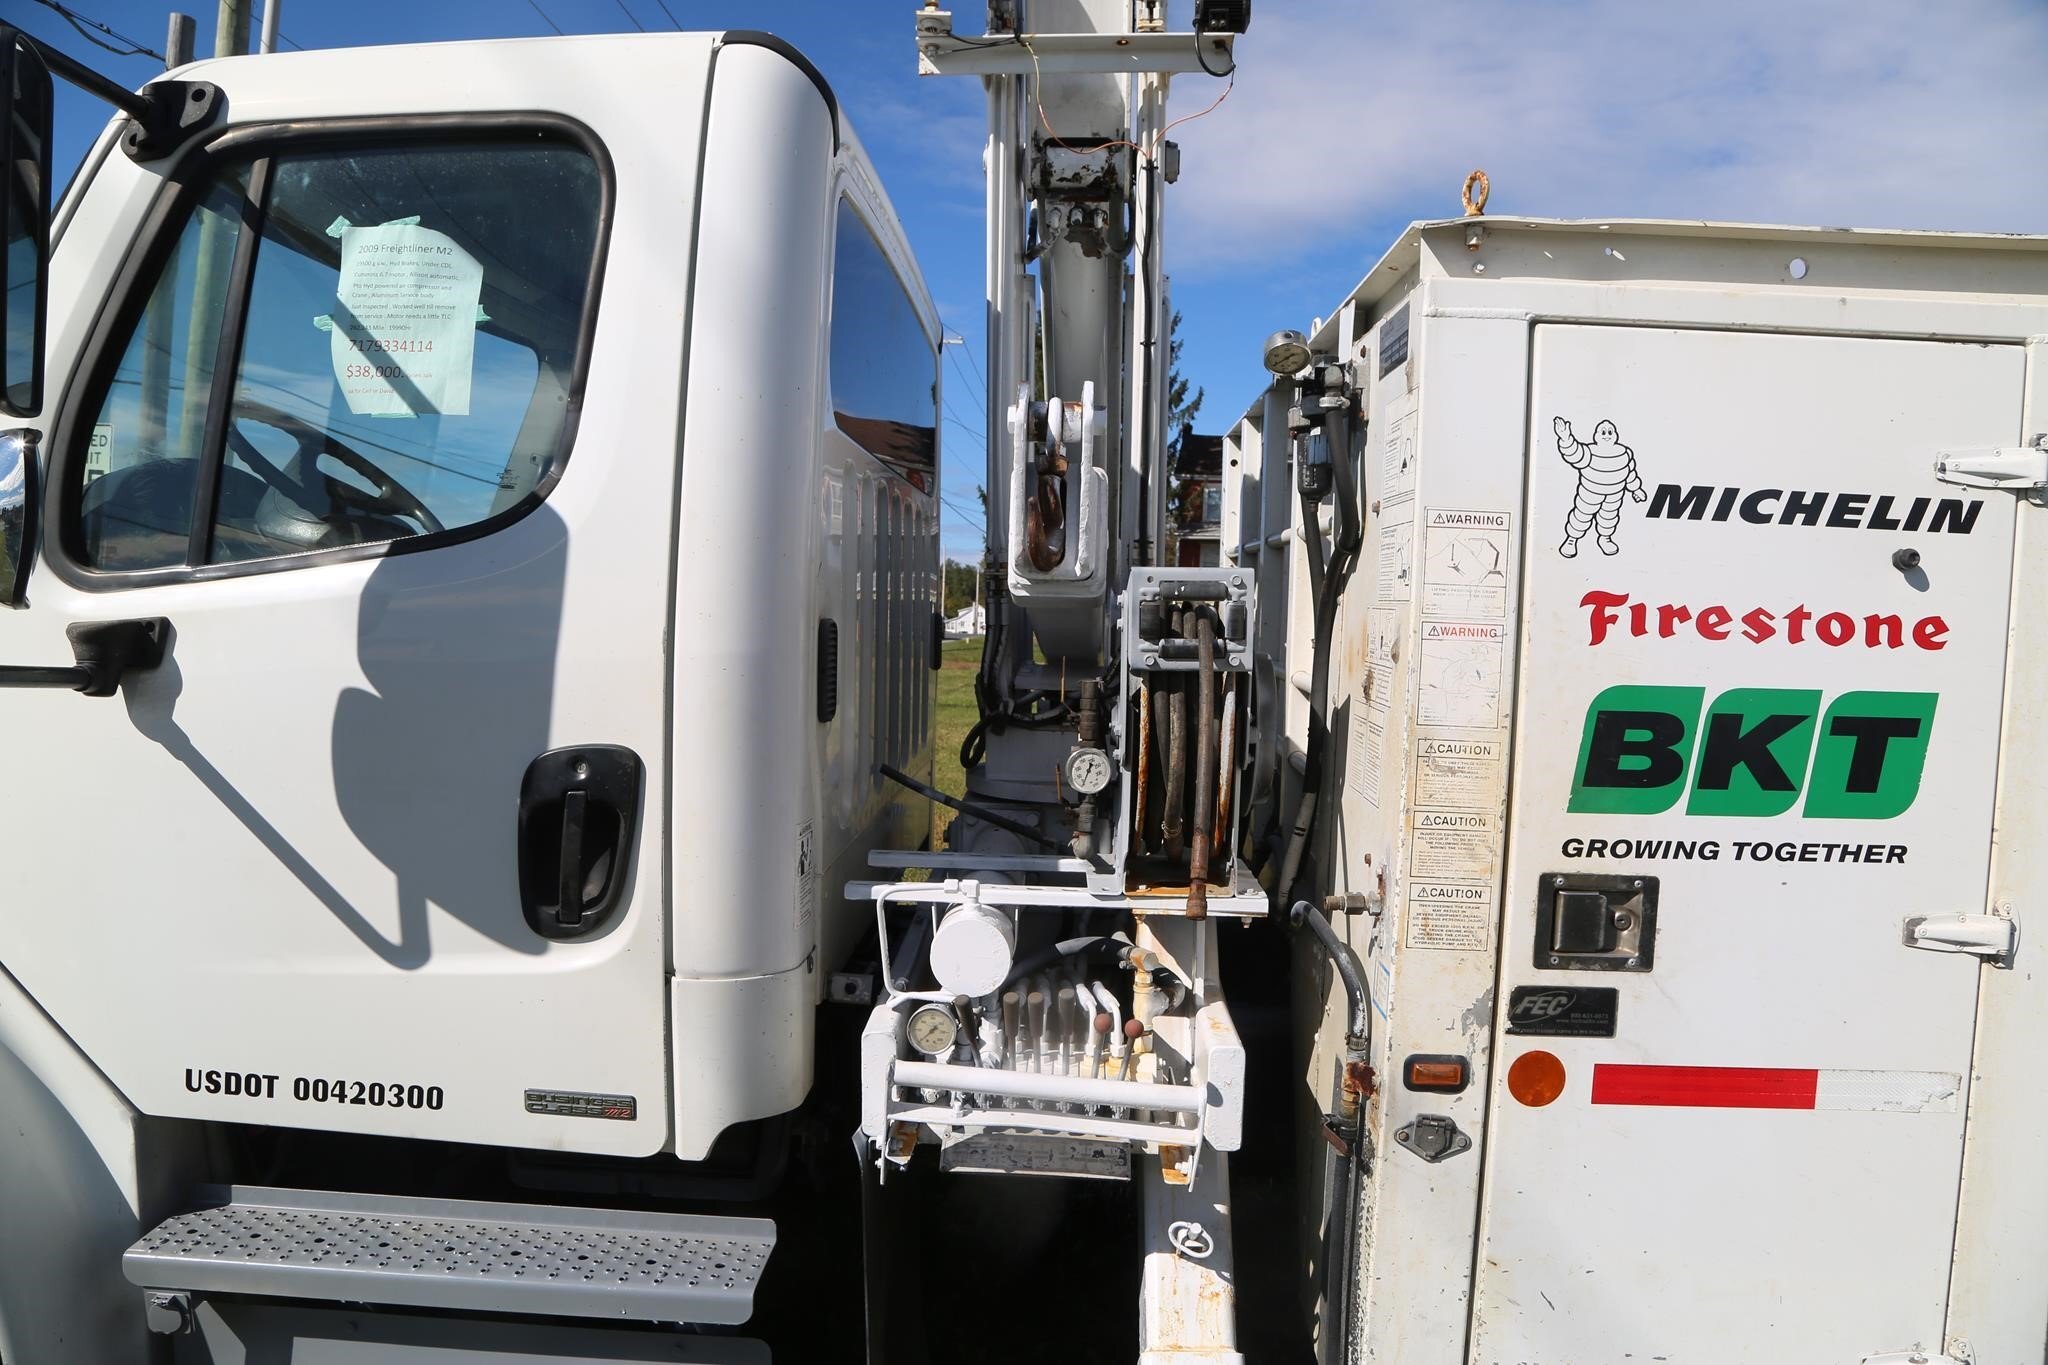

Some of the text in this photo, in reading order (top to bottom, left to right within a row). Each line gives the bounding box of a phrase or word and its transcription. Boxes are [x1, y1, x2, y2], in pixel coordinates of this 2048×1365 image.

[359, 244, 453, 255] 2009 Freightliner M2
[349, 340, 433, 352] 7179334114
[1645, 484, 1985, 535] MICHELIN
[1446, 514, 1503, 526] WARNING
[1579, 590, 1951, 651] Firestone
[1440, 626, 1497, 638] WARNING
[1438, 744, 1491, 755] CAUTION
[1582, 710, 1922, 793] BKT
[1434, 816, 1486, 827] CAUTION
[1562, 838, 1908, 864] GROWING TOGETHER
[1430, 888, 1482, 899] CAUTION
[1516, 996, 1568, 1016] FEC
[185, 1068, 444, 1110] USDOT 00420300
[527, 1094, 632, 1107] BUSINESS
[527, 1103, 600, 1115] CLASS
